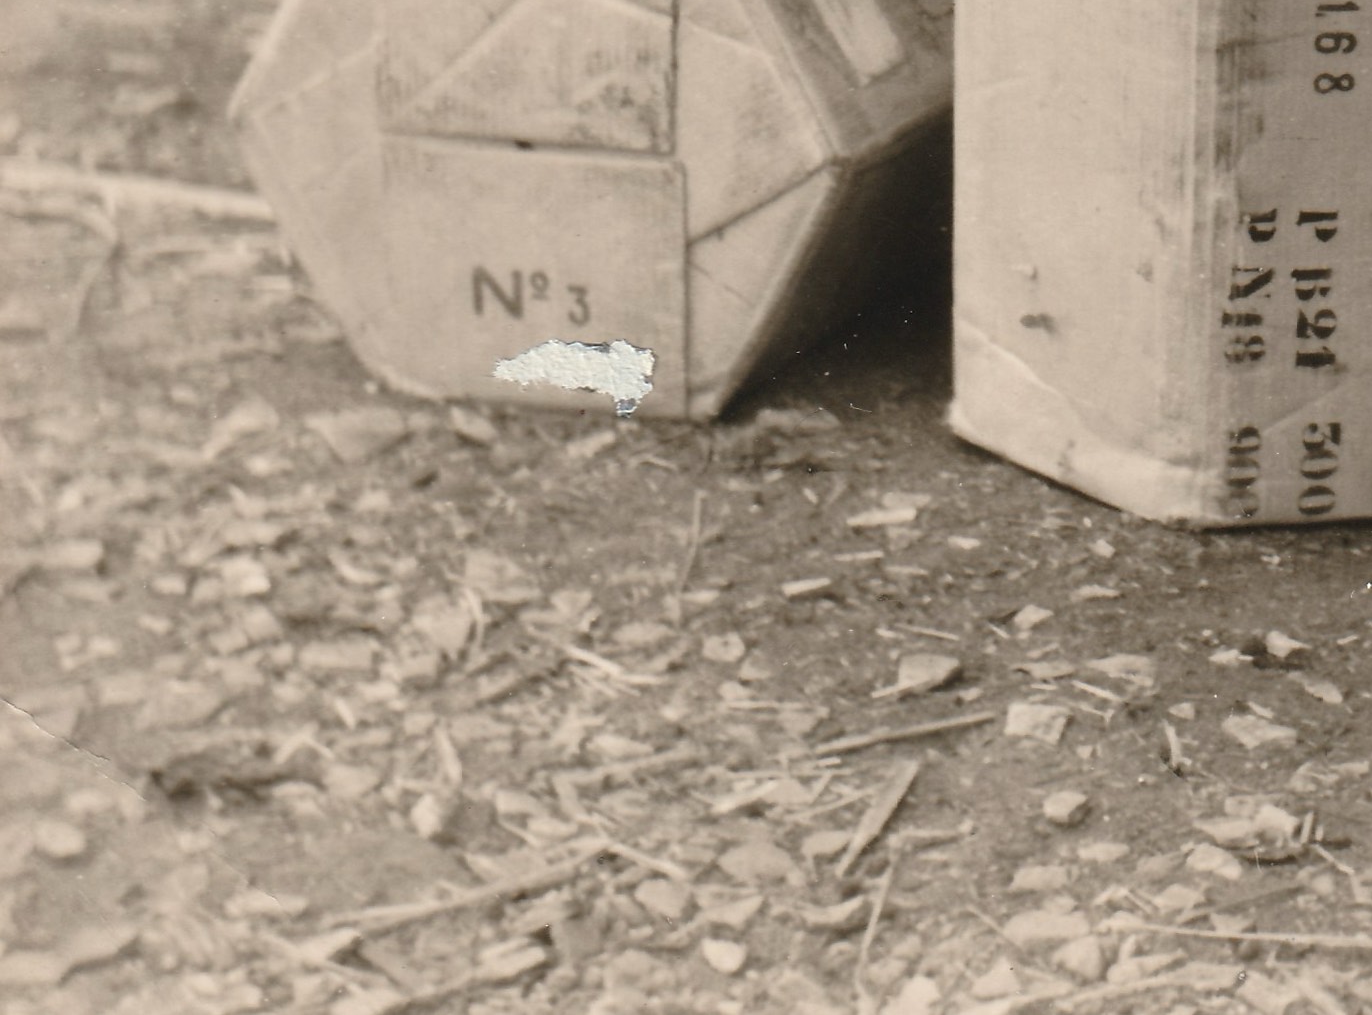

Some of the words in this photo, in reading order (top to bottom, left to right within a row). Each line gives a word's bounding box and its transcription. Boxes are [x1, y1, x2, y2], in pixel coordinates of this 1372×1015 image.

[1239, 208, 1278, 243] P
[1297, 210, 1339, 242] P
[566, 283, 590, 326] 3
